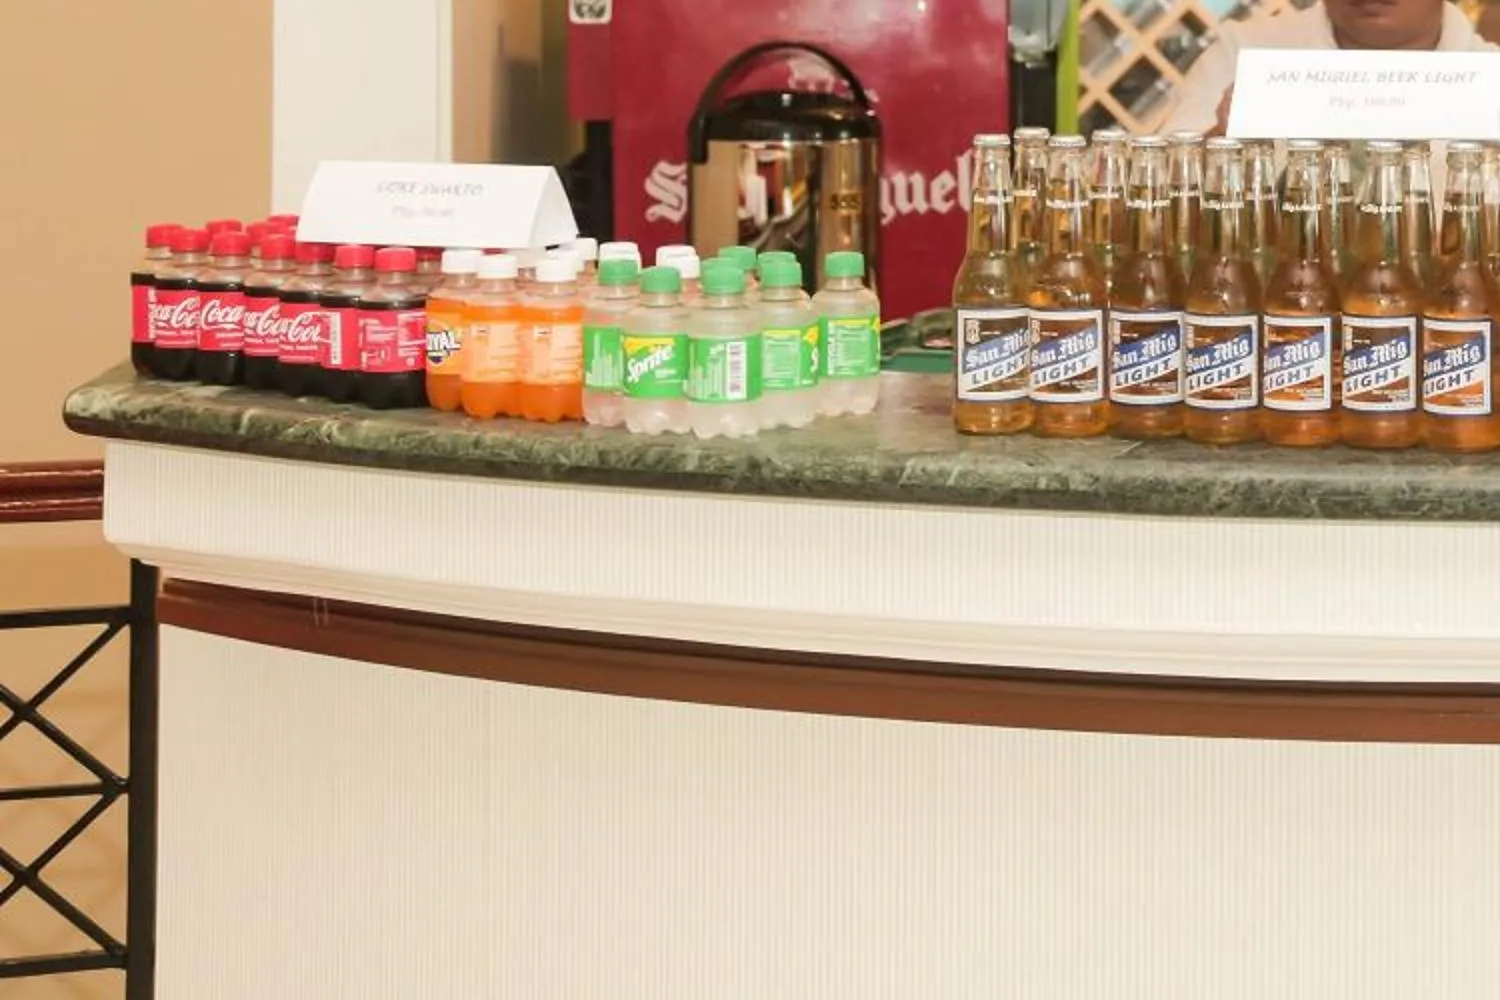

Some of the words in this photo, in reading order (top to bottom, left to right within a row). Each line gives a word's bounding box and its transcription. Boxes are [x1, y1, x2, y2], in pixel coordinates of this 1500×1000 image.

[965, 349, 998, 369] San
[1058, 332, 1095, 359] Mig
[1141, 333, 1177, 360] Mig
[1211, 337, 1249, 366] Mig
[1264, 354, 1281, 373] an
[1283, 339, 1321, 366] Mig
[1369, 339, 1407, 367] Mig
[1443, 343, 1481, 371] Mig
[1035, 358, 1089, 385] LIGHT
[1115, 358, 1171, 386] LIGHT
[1189, 363, 1244, 390] LIGHT
[1345, 365, 1401, 392] LIGHT
